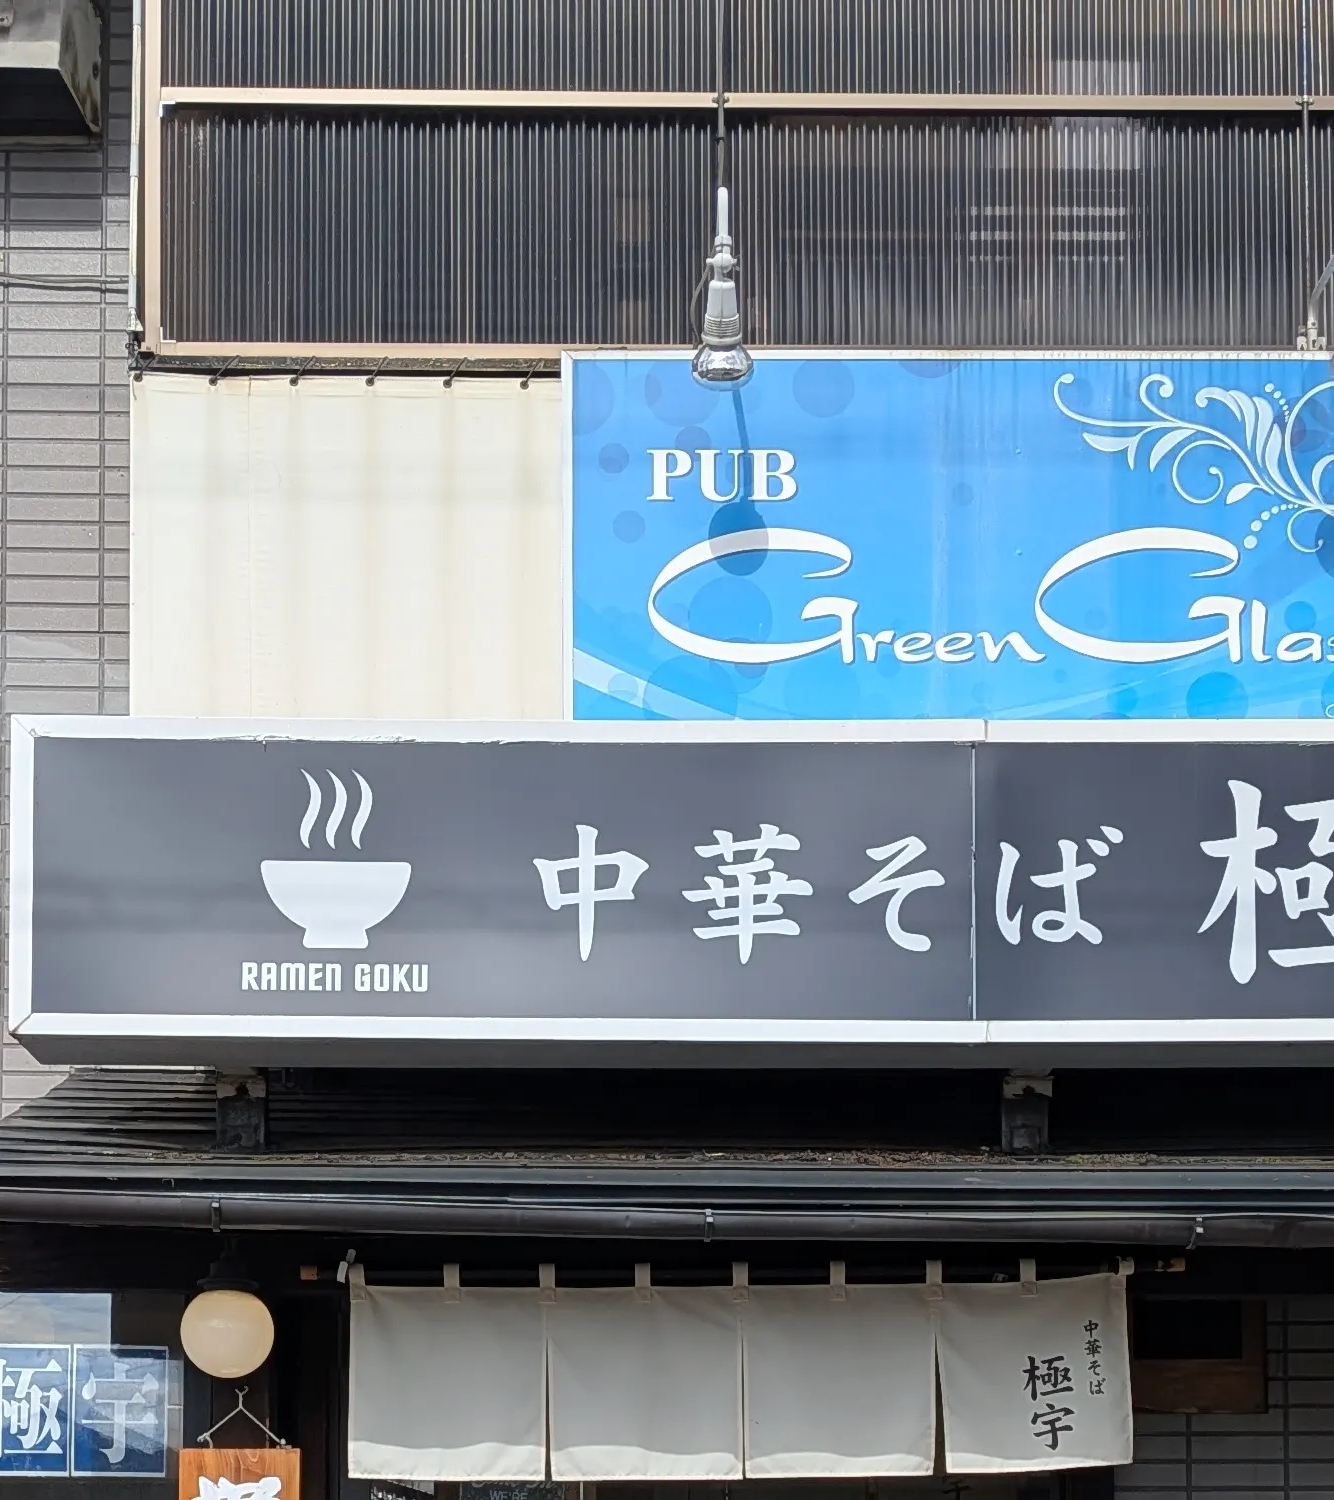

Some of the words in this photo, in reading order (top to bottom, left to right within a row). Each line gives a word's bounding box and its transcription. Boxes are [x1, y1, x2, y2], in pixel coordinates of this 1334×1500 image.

[646, 449, 798, 502] PUB
[647, 527, 1046, 664] Green
[532, 822, 1124, 966] 中華そば
[241, 962, 342, 993] RAMEN
[354, 962, 429, 993] GOKU
[1083, 1320, 1106, 1396] 中華そば
[1022, 1355, 1075, 1451] 極宇
